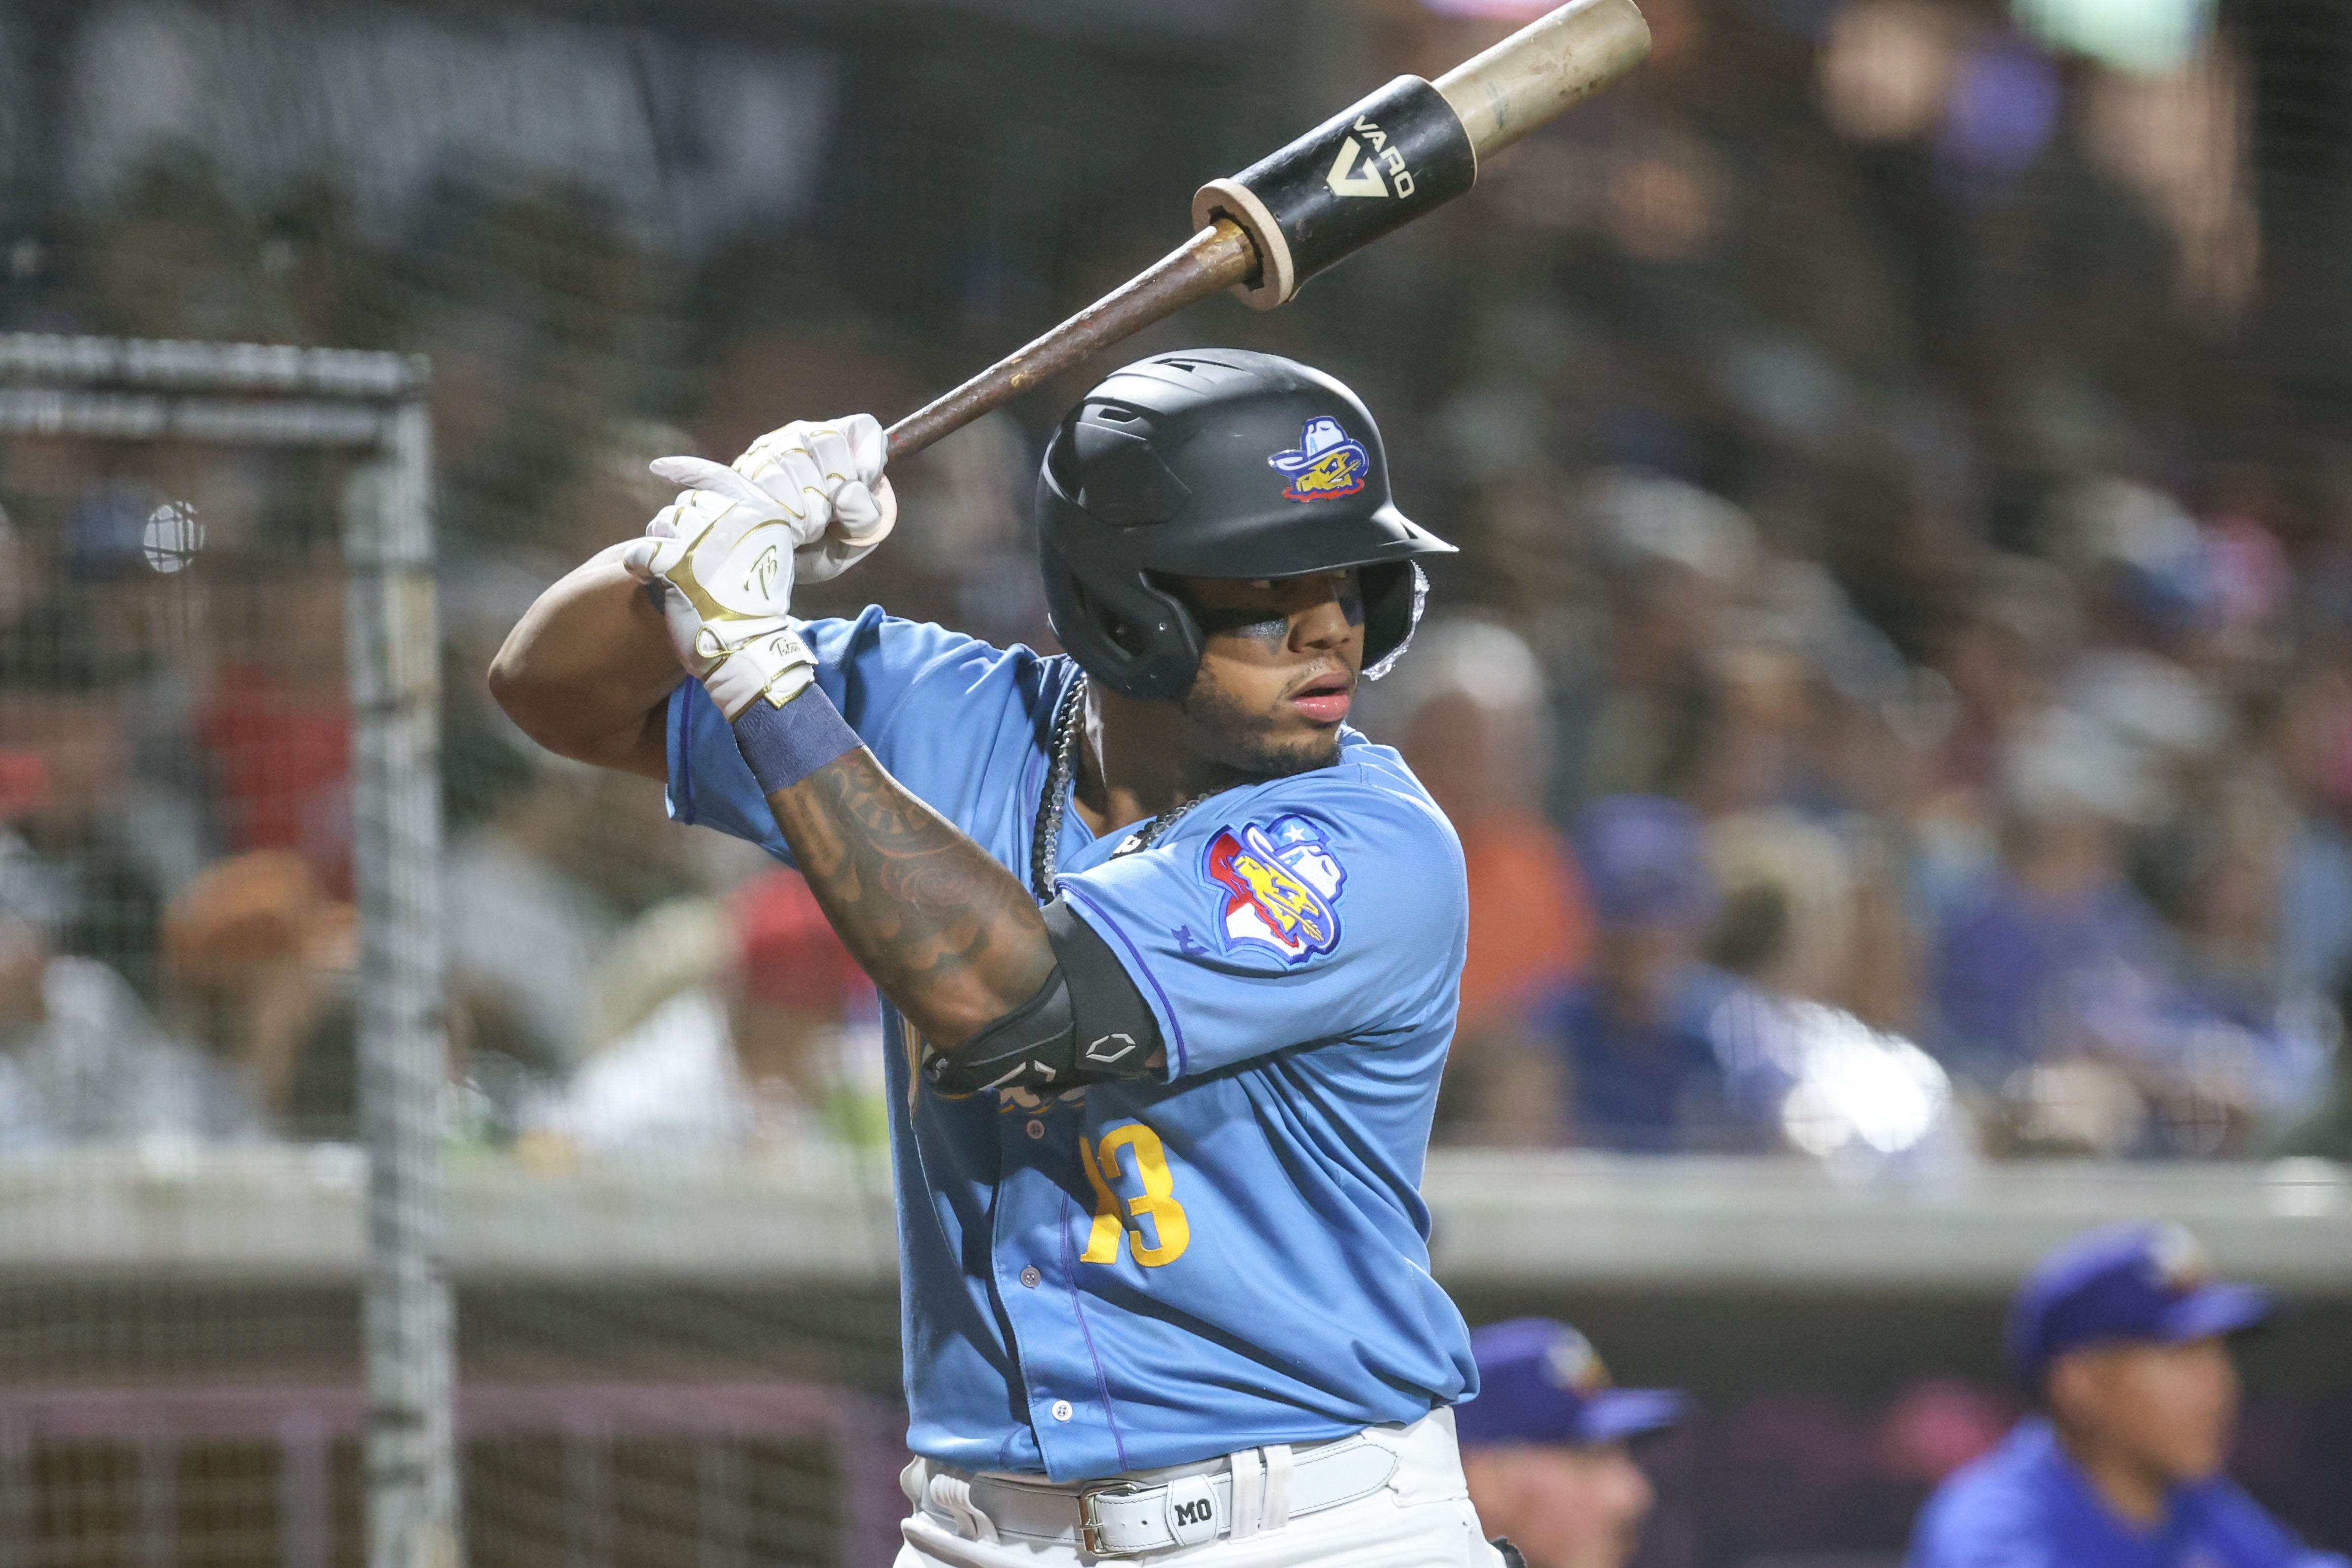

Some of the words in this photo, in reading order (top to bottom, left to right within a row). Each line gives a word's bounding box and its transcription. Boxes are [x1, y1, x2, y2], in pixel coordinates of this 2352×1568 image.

[1353, 115, 1415, 199] VARO
[1079, 1124, 1190, 1267] 13
[1175, 1498, 1213, 1526] MO
